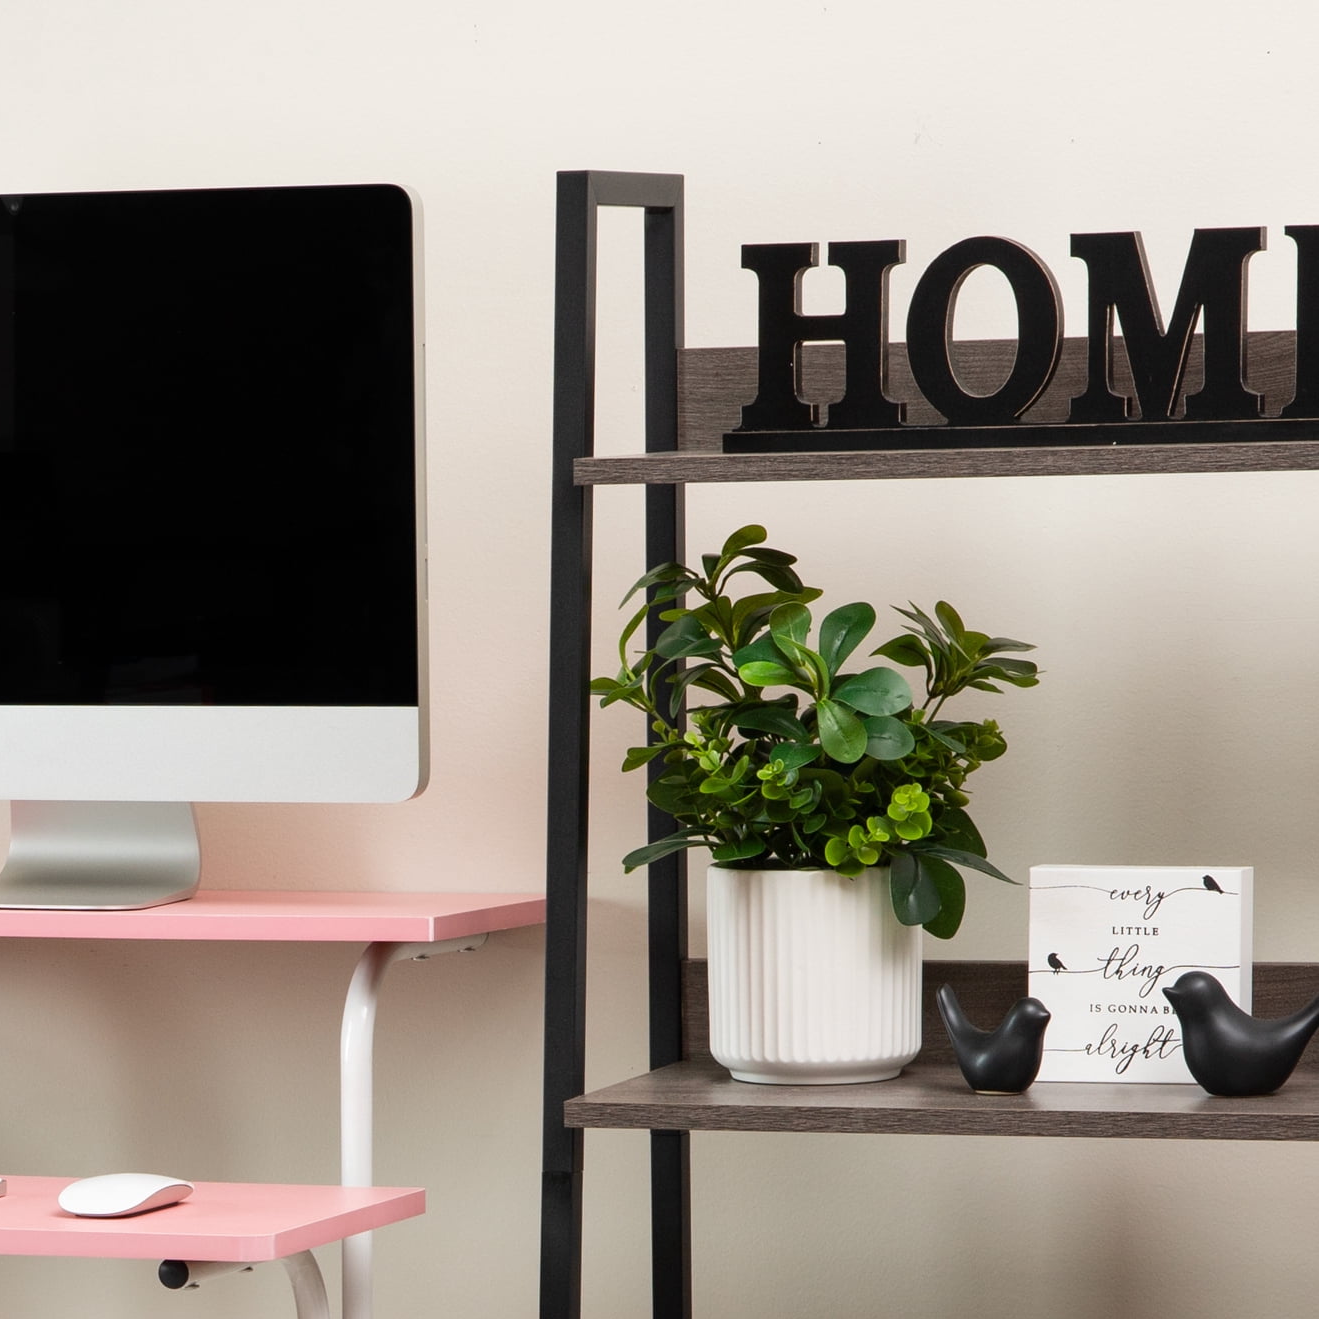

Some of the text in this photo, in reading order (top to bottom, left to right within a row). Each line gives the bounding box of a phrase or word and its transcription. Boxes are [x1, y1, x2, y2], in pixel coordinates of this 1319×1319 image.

[1109, 885, 1167, 920] every
[1112, 926, 1160, 937] LITTLE
[1097, 943, 1166, 999] thing
[1089, 1003, 1102, 1013] IS
[1107, 1004, 1159, 1015] GONNA
[1085, 1023, 1181, 1075] alright
